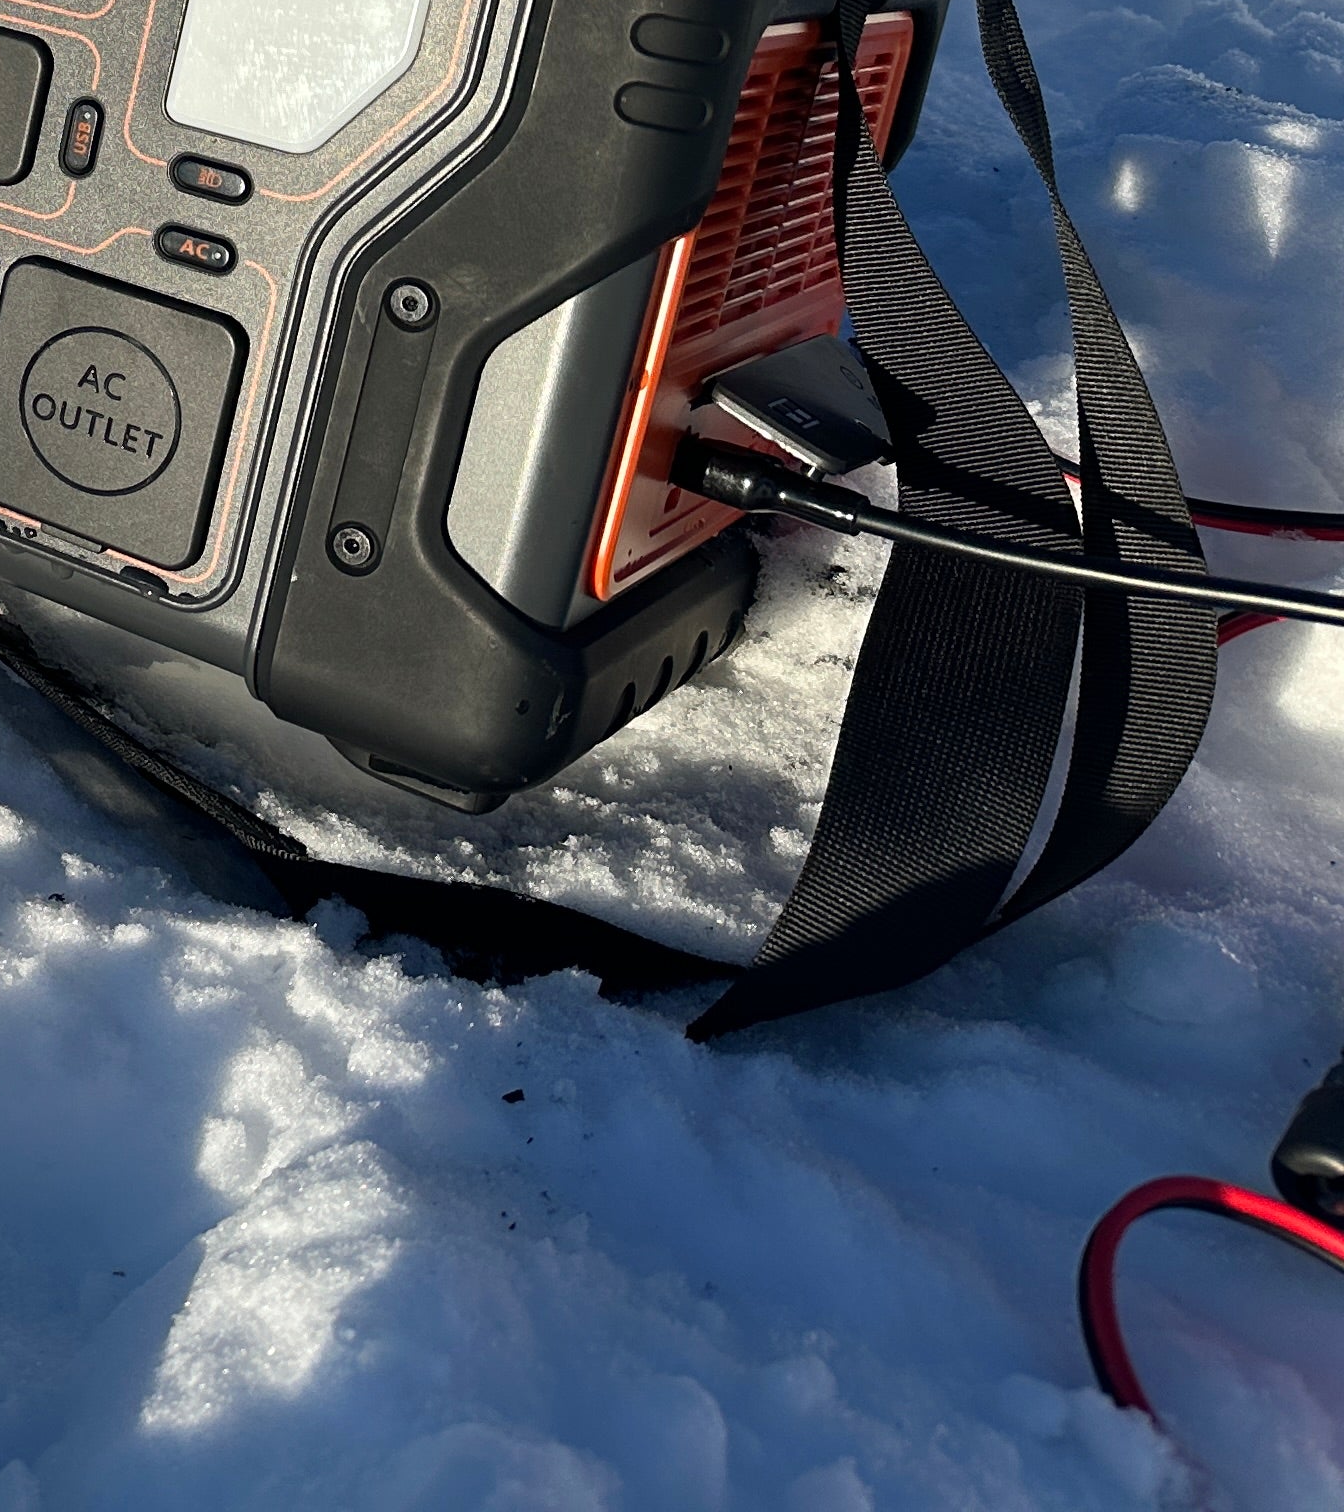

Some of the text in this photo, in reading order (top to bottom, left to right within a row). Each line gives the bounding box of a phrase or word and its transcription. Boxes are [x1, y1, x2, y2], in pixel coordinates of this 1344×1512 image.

[73, 121, 91, 156] USB
[179, 239, 210, 260] AC
[77, 364, 127, 401] AC
[32, 393, 164, 459] OUTLET
